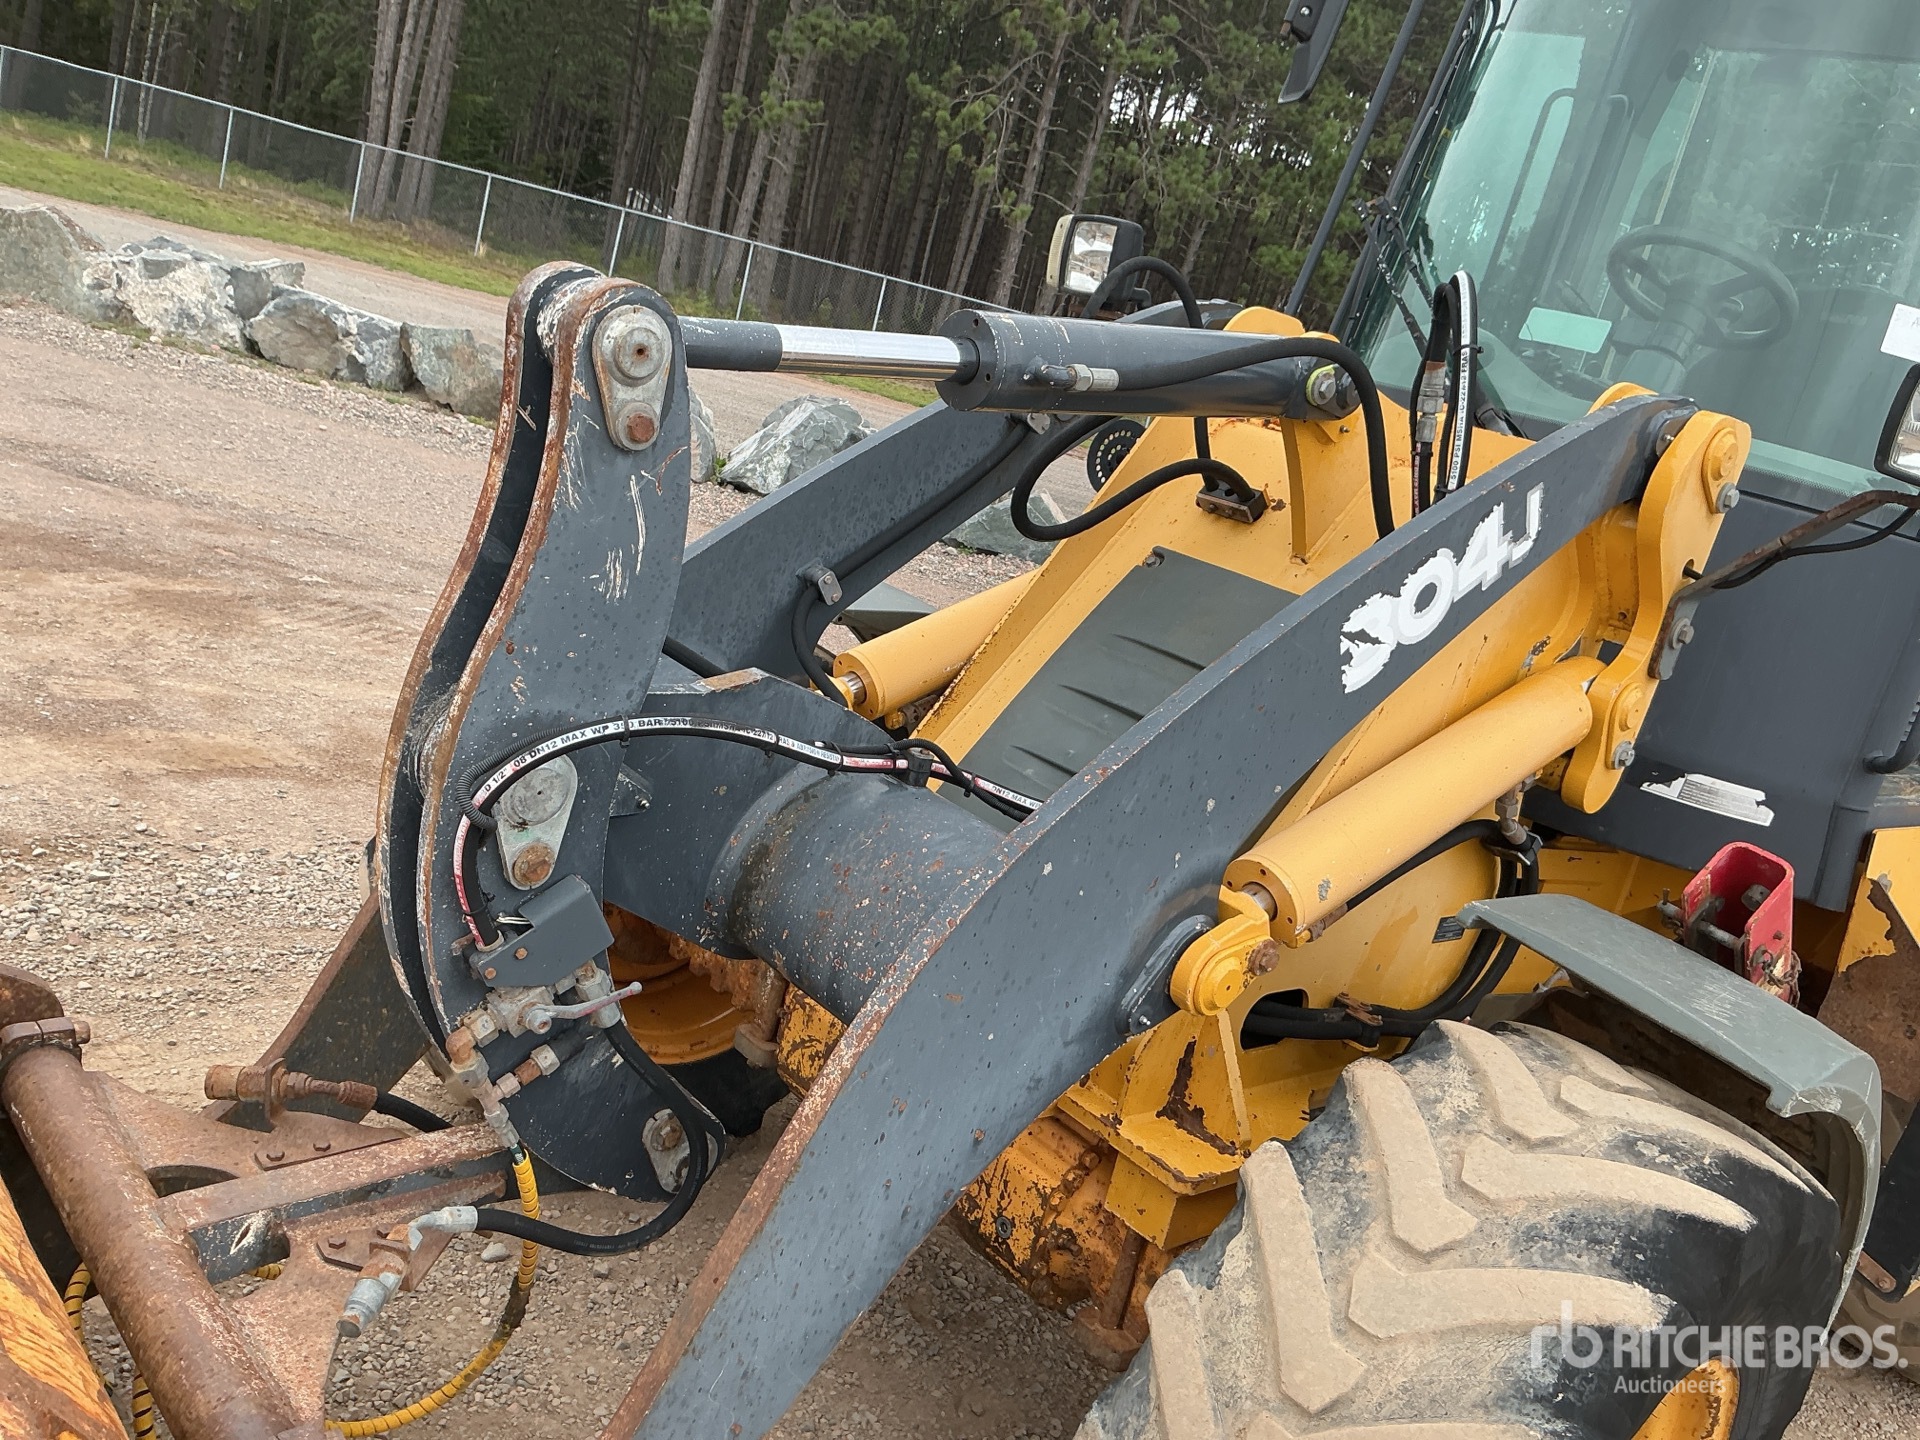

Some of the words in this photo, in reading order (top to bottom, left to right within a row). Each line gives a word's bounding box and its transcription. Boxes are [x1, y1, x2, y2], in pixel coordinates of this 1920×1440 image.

[1450, 461, 1459, 479] 5100
[513, 755, 527, 768] 08
[529, 740, 558, 759] DN12
[560, 730, 588, 745] MAX
[590, 724, 610, 736] WP
[638, 718, 661, 728] BAR
[1011, 793, 1029, 805] MAX
